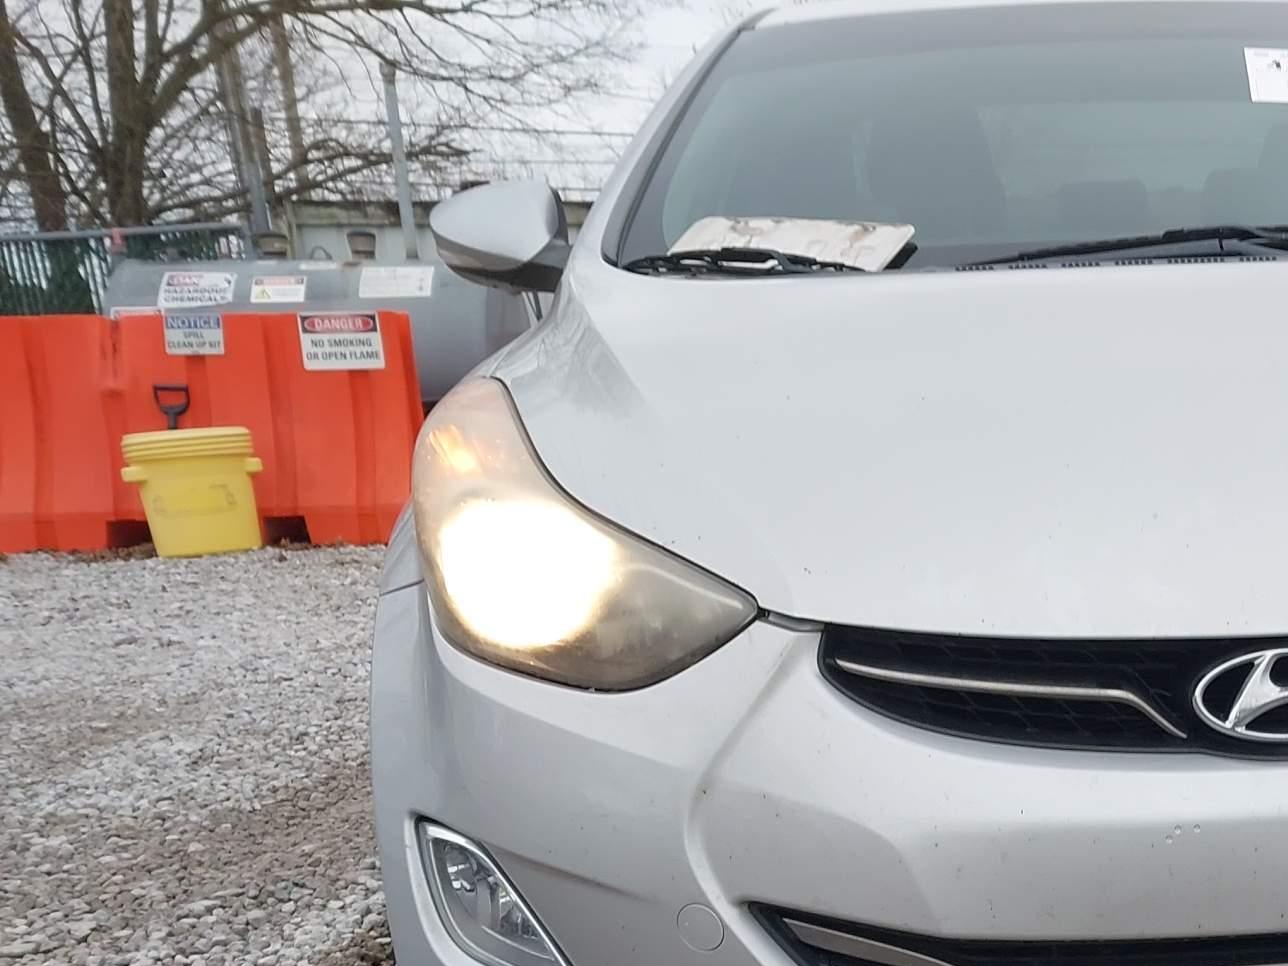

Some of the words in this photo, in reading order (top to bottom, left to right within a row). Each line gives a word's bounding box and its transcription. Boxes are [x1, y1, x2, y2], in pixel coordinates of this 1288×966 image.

[167, 317, 219, 329] NOTICE
[313, 317, 364, 330] DANGER
[184, 330, 205, 339] SPILL
[167, 340, 194, 349] CLEAN
[310, 338, 325, 348] NO
[327, 337, 373, 348] SMOKING
[306, 351, 320, 361] OR
[321, 351, 347, 360] OPEN
[349, 350, 379, 360] FLAME
